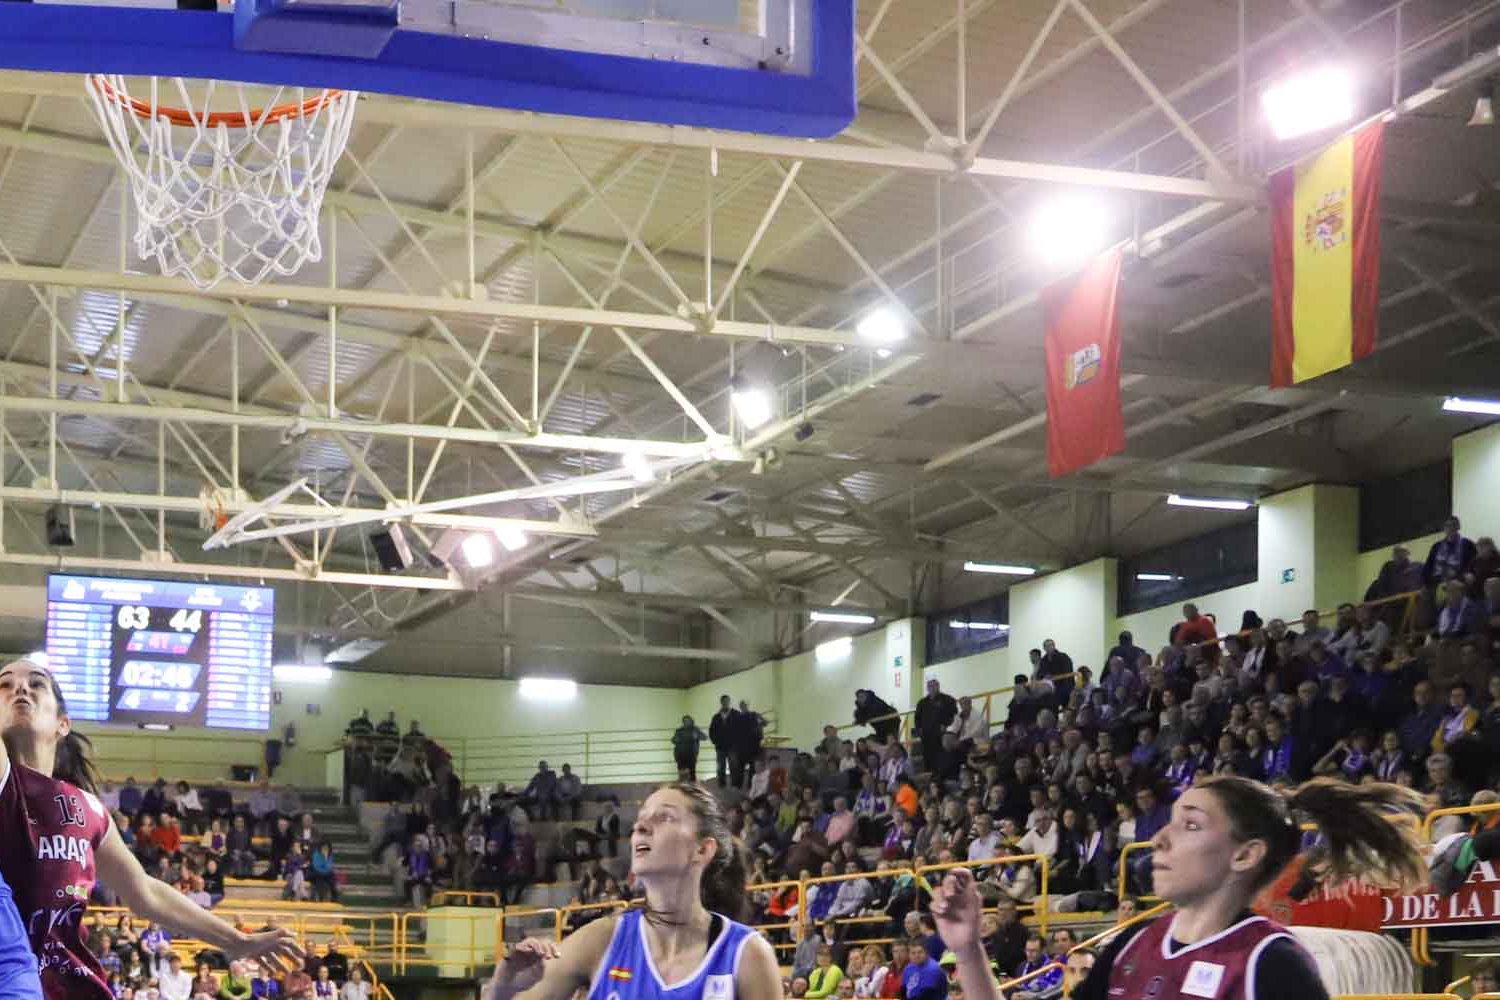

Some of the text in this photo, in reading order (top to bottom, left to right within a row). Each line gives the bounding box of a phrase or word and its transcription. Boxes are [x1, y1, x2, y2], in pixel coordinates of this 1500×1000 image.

[118, 606, 202, 633] 63 44
[37, 834, 90, 871] ARAS
[1402, 894, 1440, 922] DE
[1449, 891, 1485, 920] LA
